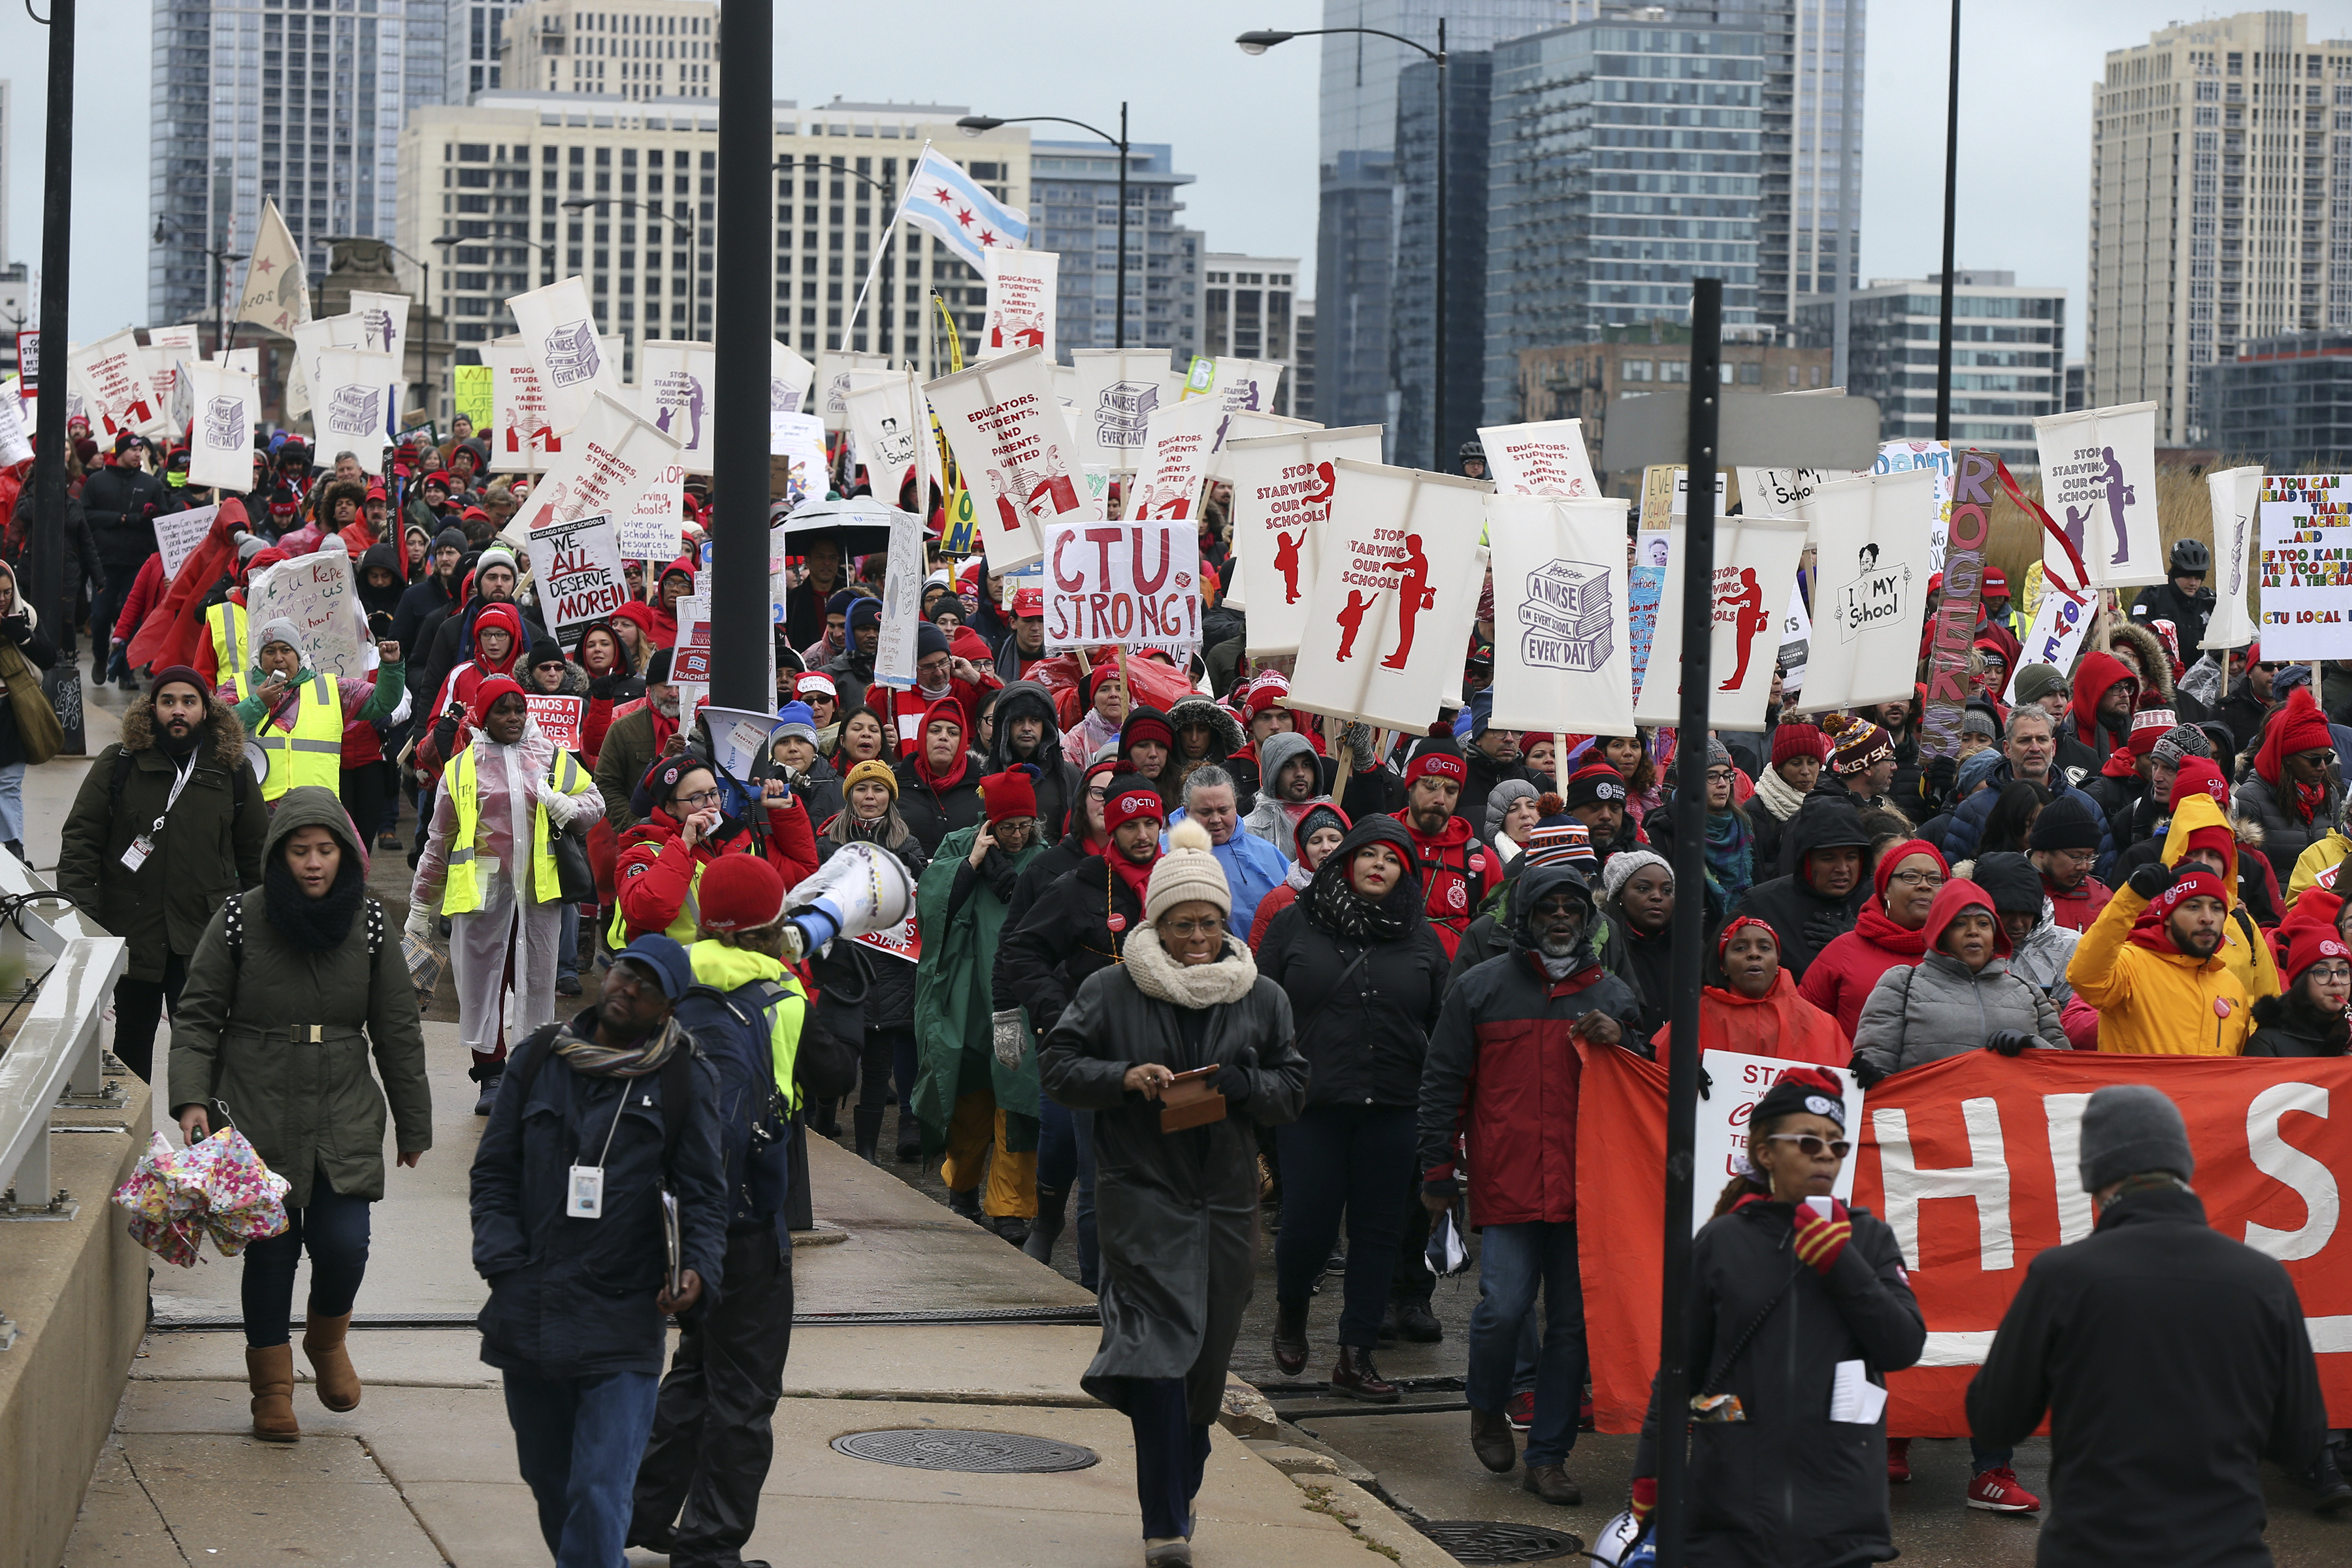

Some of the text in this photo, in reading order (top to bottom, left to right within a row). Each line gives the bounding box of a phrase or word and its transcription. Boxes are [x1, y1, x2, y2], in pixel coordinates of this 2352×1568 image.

[998, 275, 1044, 285] EDUCATORS,
[1000, 284, 1041, 292] STUDENTS,
[1002, 299, 1036, 308] PARENTS
[549, 342, 555, 351] A
[86, 352, 127, 372] EDUCATORS,
[91, 361, 127, 379] STUDENTS,
[105, 372, 120, 382] AND
[557, 365, 588, 384] EVERY DAY
[99, 376, 129, 393] PARENTS
[105, 385, 129, 399] UNITED
[656, 397, 689, 406] SCHOOLS
[967, 393, 1039, 423] EDUCATORS,
[1103, 393, 1136, 412] A NURSE
[977, 408, 1039, 433] STUDENTS,
[1105, 414, 1117, 423] EVERY
[1117, 418, 1132, 427] SCHOOL
[899, 434, 912, 448] MY
[998, 427, 1021, 441] AND
[1102, 431, 1143, 445] EVERY DAY
[1158, 434, 1203, 448] EDUCATORS,
[992, 434, 1041, 457] PARENTS
[1159, 446, 1198, 457] STUDENTS,
[1507, 444, 1569, 453] EDUCATORS,
[1000, 449, 1040, 468] UNITED
[1512, 451, 1568, 461] STUDENTS,
[2074, 448, 2100, 459] STOP
[587, 442, 637, 480] EDUCATORS,
[585, 454, 626, 486] STUDENTS,
[1157, 466, 1190, 476] PARENTS
[1282, 463, 1315, 480] STOP
[1522, 467, 1567, 478] PARENTS
[2053, 462, 2104, 476] STARVING
[592, 472, 608, 485] AND
[1157, 476, 1184, 484] UNITED
[1529, 476, 1565, 485] UNITED
[1769, 472, 1777, 486] I
[2063, 478, 2087, 489] OUR
[2262, 476, 2340, 490] IF YOU CAN
[576, 475, 610, 501] PARENTS
[1257, 480, 1322, 499] STARVING
[574, 487, 600, 508] UNITED
[2058, 489, 2106, 503] SCHOOLS
[2262, 490, 2328, 502] READ THIS
[1271, 499, 1300, 514] OUR
[1266, 510, 1325, 530] SCHOOLS
[2293, 515, 2350, 528] TEACHER
[532, 517, 604, 540] CHICAGO PUBLIC SCHOOLS
[624, 529, 675, 540] schools the
[1373, 529, 1405, 541] STOP
[549, 532, 580, 553] WE
[2279, 531, 2323, 544] ...AND
[168, 546, 180, 557] and
[622, 549, 648, 559] needed
[1344, 540, 1406, 559] STARVING
[2262, 548, 2342, 563] EF YOO KAN
[551, 548, 595, 576] ALL
[1053, 527, 1169, 596] CTU
[1352, 558, 1380, 573] OUR
[2262, 562, 2319, 575] THS YOO
[313, 565, 344, 583] Kepe
[1342, 571, 1399, 589] SCHOOLS
[1403, 568, 1415, 578] CPS
[1712, 566, 1739, 580] STOP
[549, 567, 613, 598] DESERVE
[2262, 575, 2300, 587] AR A
[322, 581, 344, 598] us
[1533, 578, 1578, 612] A NURSE
[1848, 575, 1897, 608] I MY
[557, 583, 625, 624] MORE!!
[1643, 600, 1659, 611] not
[1921, 453, 1995, 759] ROGERS
[308, 611, 334, 629] hour
[1049, 593, 1196, 640] STRONG!
[1850, 598, 1897, 629] School
[2263, 611, 2341, 624] CTU LOCAL
[1522, 610, 1571, 636] IN EVERY SCHOOL
[261, 627, 274, 636] CTU
[678, 649, 700, 657] SUPPORT
[1529, 638, 1588, 665] EVERY DAY
[1780, 647, 1801, 655] CHICAGO
[1780, 651, 1803, 661] TEACHERS
[675, 670, 710, 681] TEACHER
[525, 698, 574, 713] AMOS A
[1839, 742, 1891, 774] RKEY 5K
[677, 759, 696, 772] CTU
[1442, 762, 1460, 772] CTU
[2208, 779, 2223, 788] CTU
[1137, 798, 1154, 807] CTU
[135, 842, 148, 853] PRESS
[1531, 835, 1588, 848] CHICAG
[2176, 880, 2197, 893] CTU
[706, 919, 736, 928] Canada
